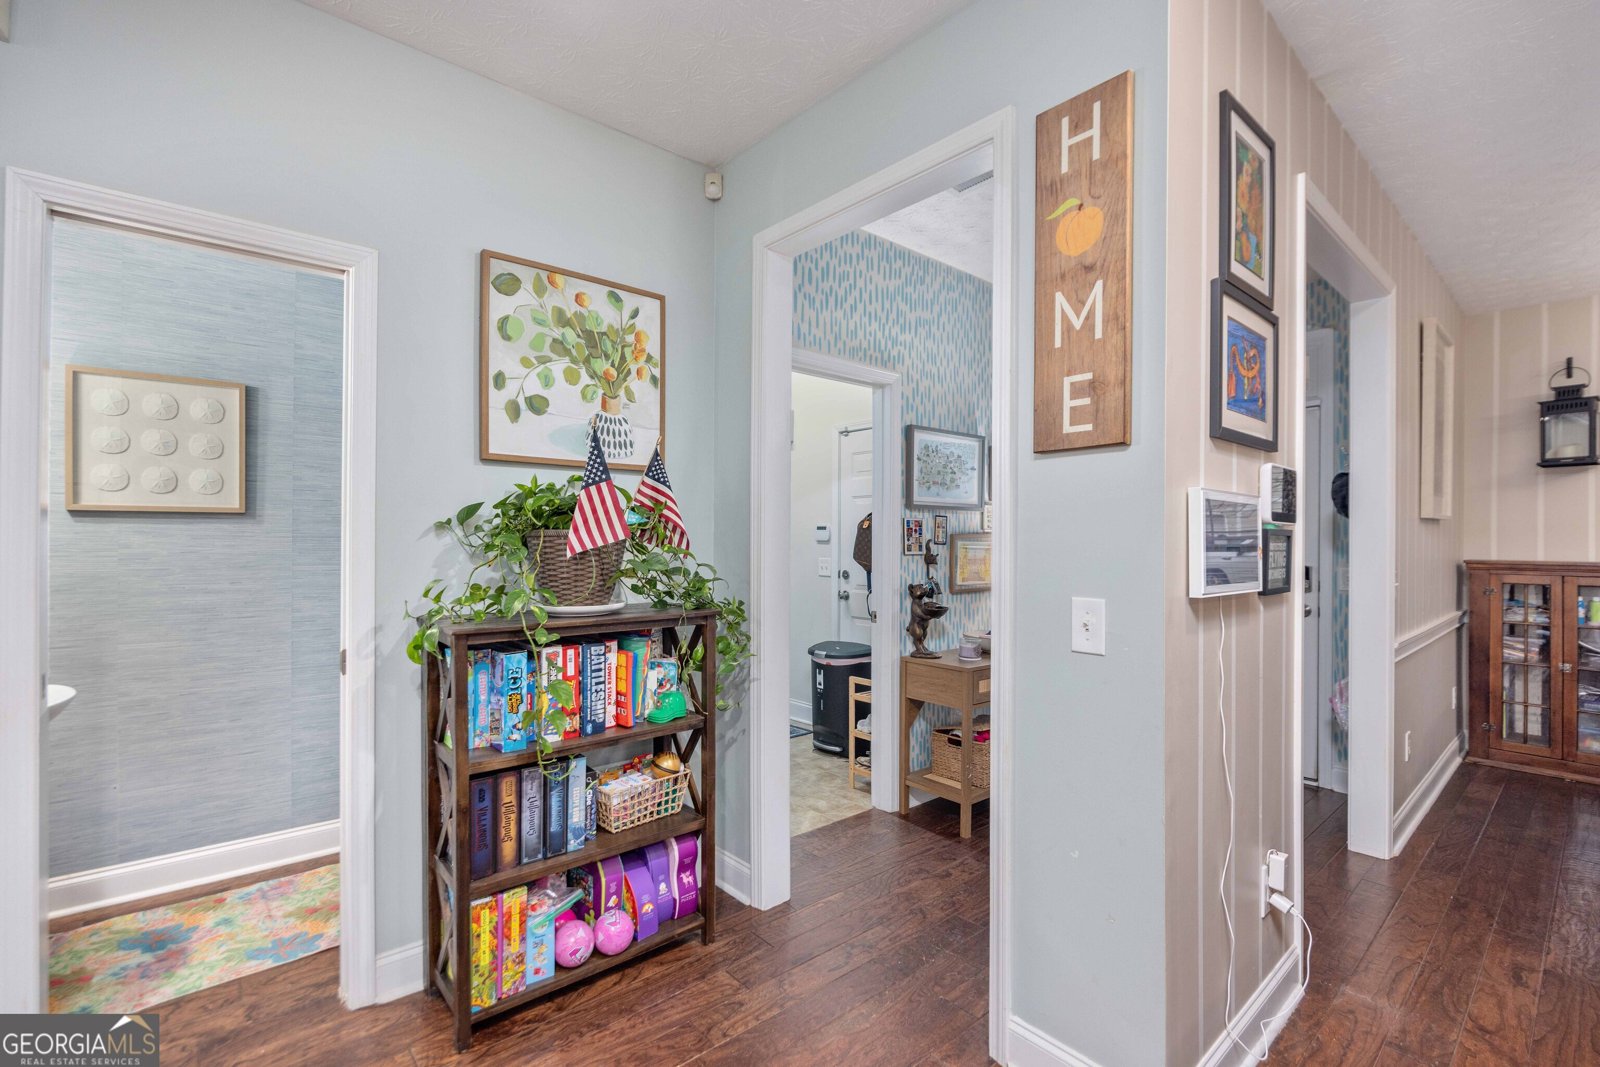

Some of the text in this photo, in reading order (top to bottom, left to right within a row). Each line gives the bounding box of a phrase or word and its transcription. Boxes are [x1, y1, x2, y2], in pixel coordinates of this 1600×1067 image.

[507, 666, 523, 694] ICE
[590, 645, 606, 723] BATTLESHIP
[502, 801, 516, 843] Villainous
